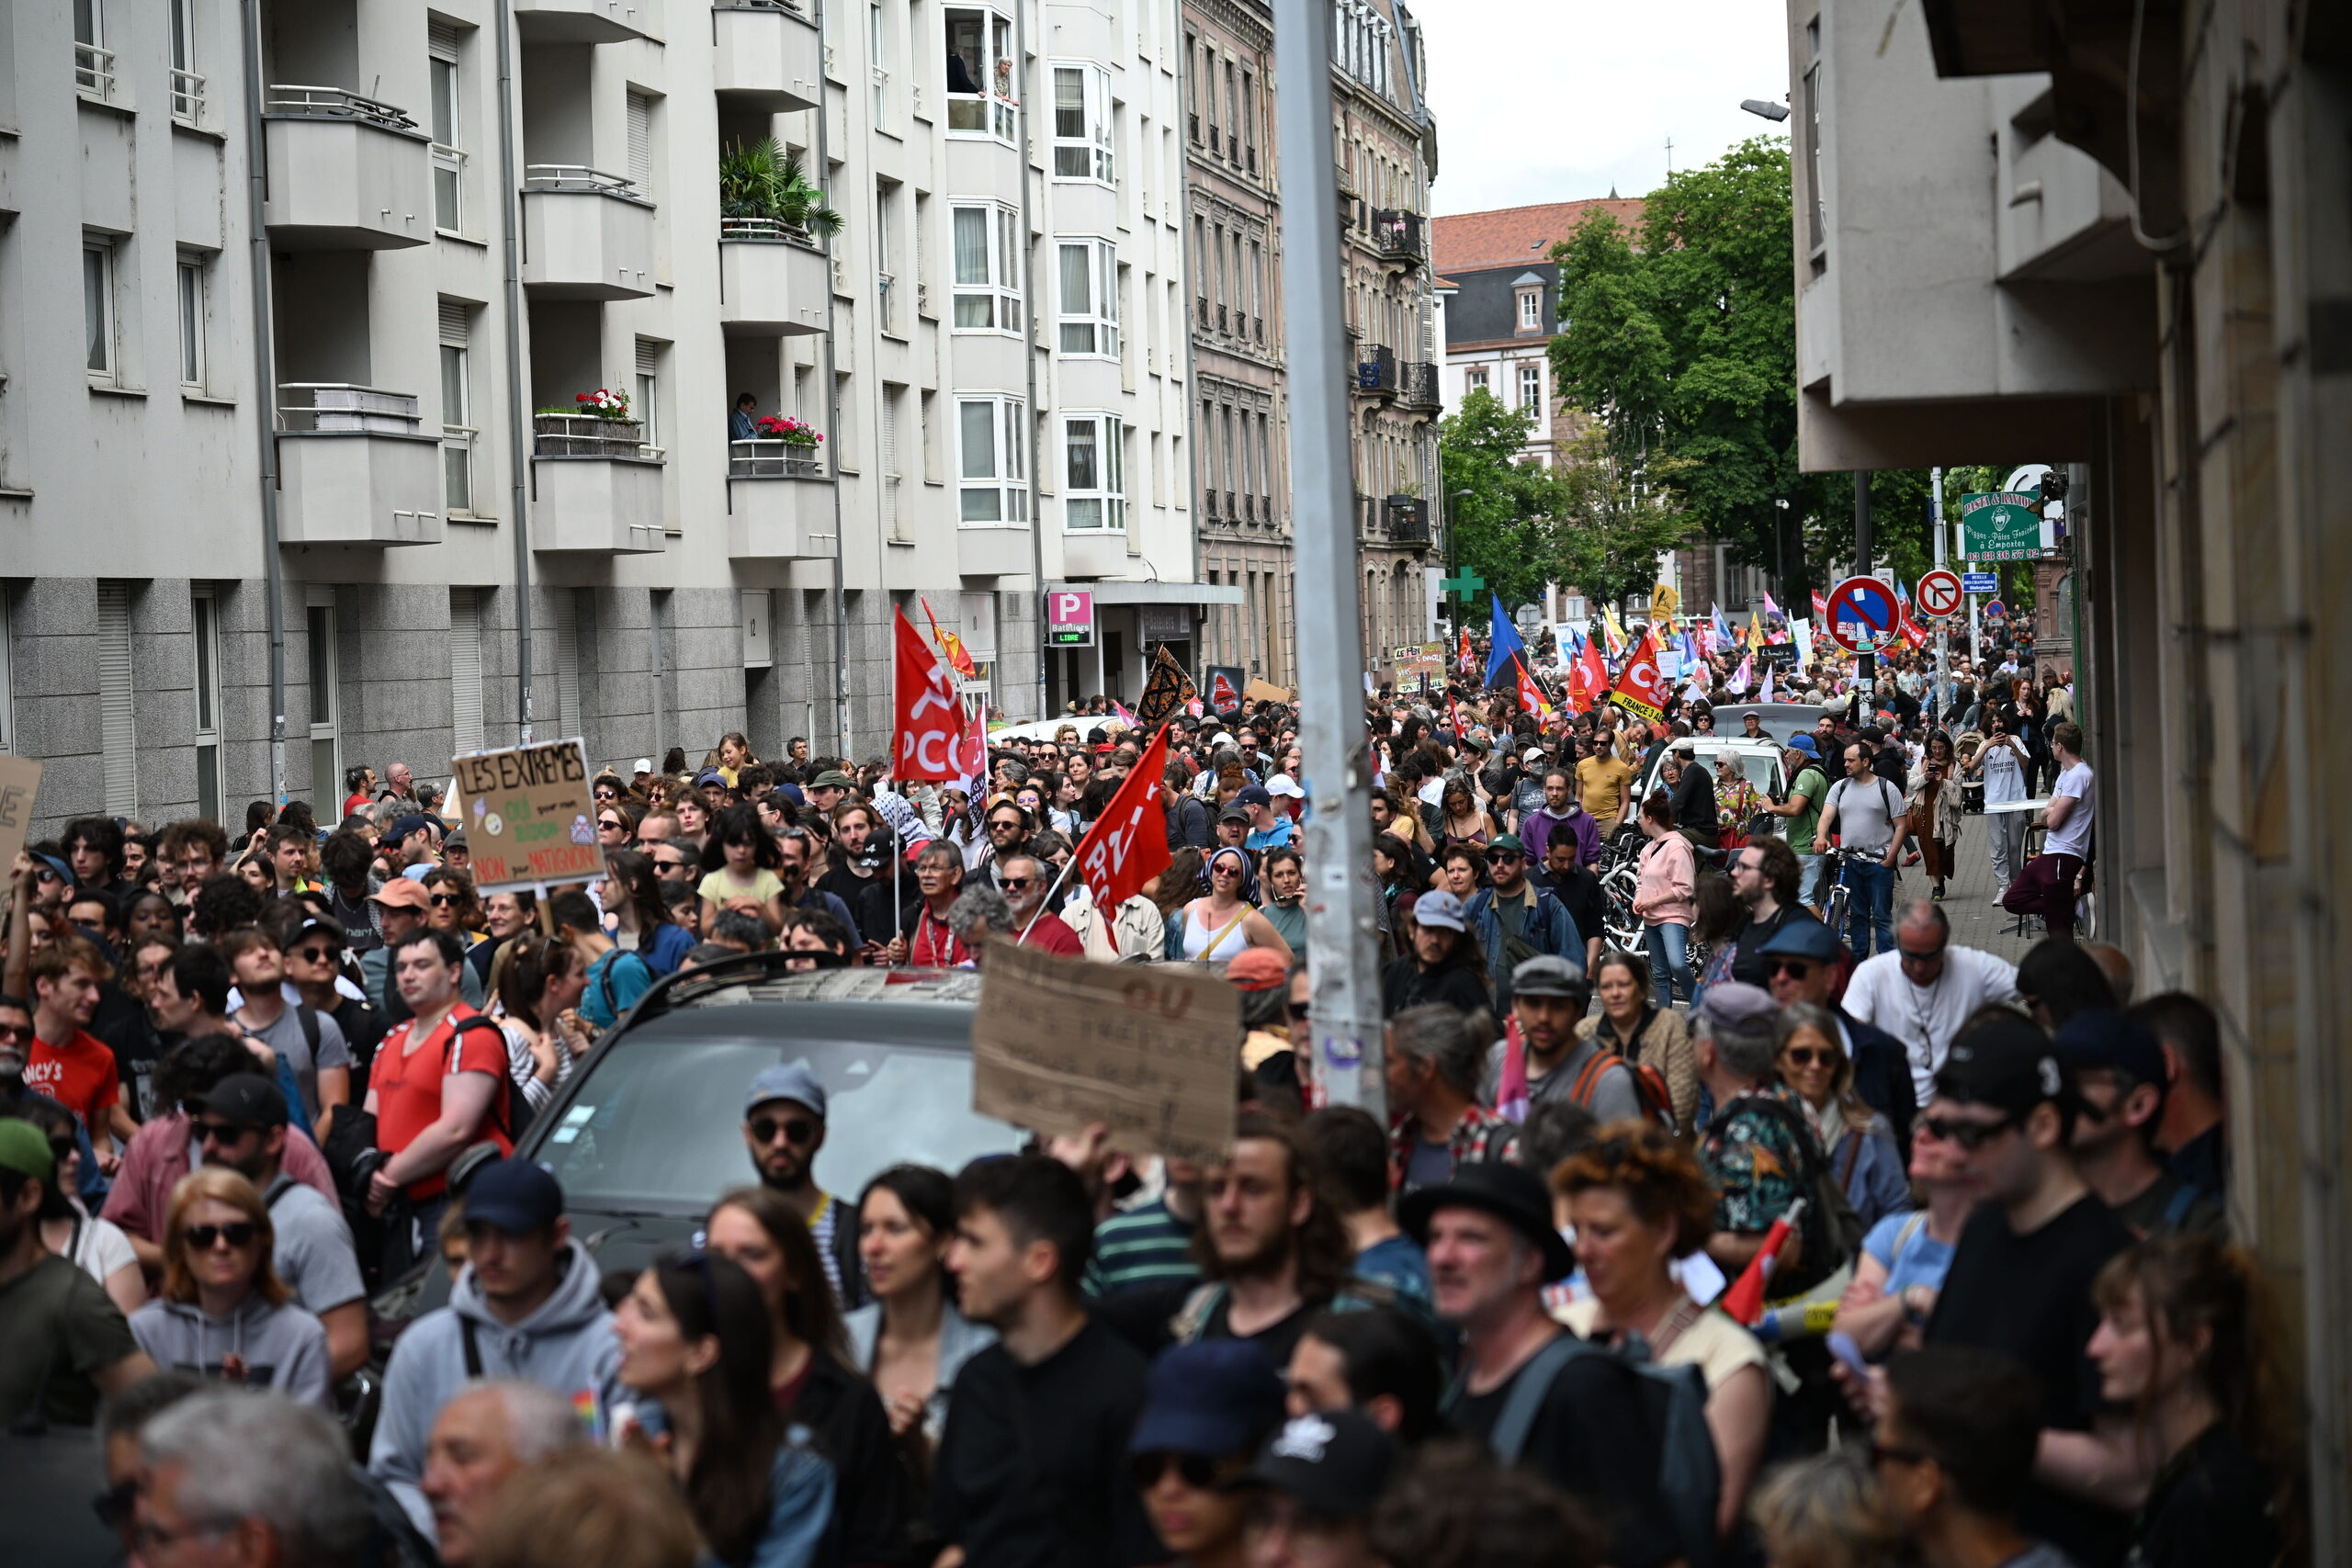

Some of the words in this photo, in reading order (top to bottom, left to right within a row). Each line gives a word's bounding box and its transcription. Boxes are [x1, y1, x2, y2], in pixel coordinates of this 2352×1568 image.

[1964, 495, 1991, 516] PASTA
[1992, 493, 1999, 505] &
[1967, 552, 1980, 561] 03
[1982, 551, 1995, 560] 88
[2026, 548, 2040, 558] 92
[1980, 541, 1984, 549] à
[1988, 539, 2025, 549] Emporter
[1059, 594, 1080, 622] P
[1623, 696, 1649, 716] FRANCE
[1649, 709, 1655, 717] 3
[458, 758, 498, 795] LES
[473, 854, 508, 884] NON
[528, 844, 597, 875] MATIGNON
